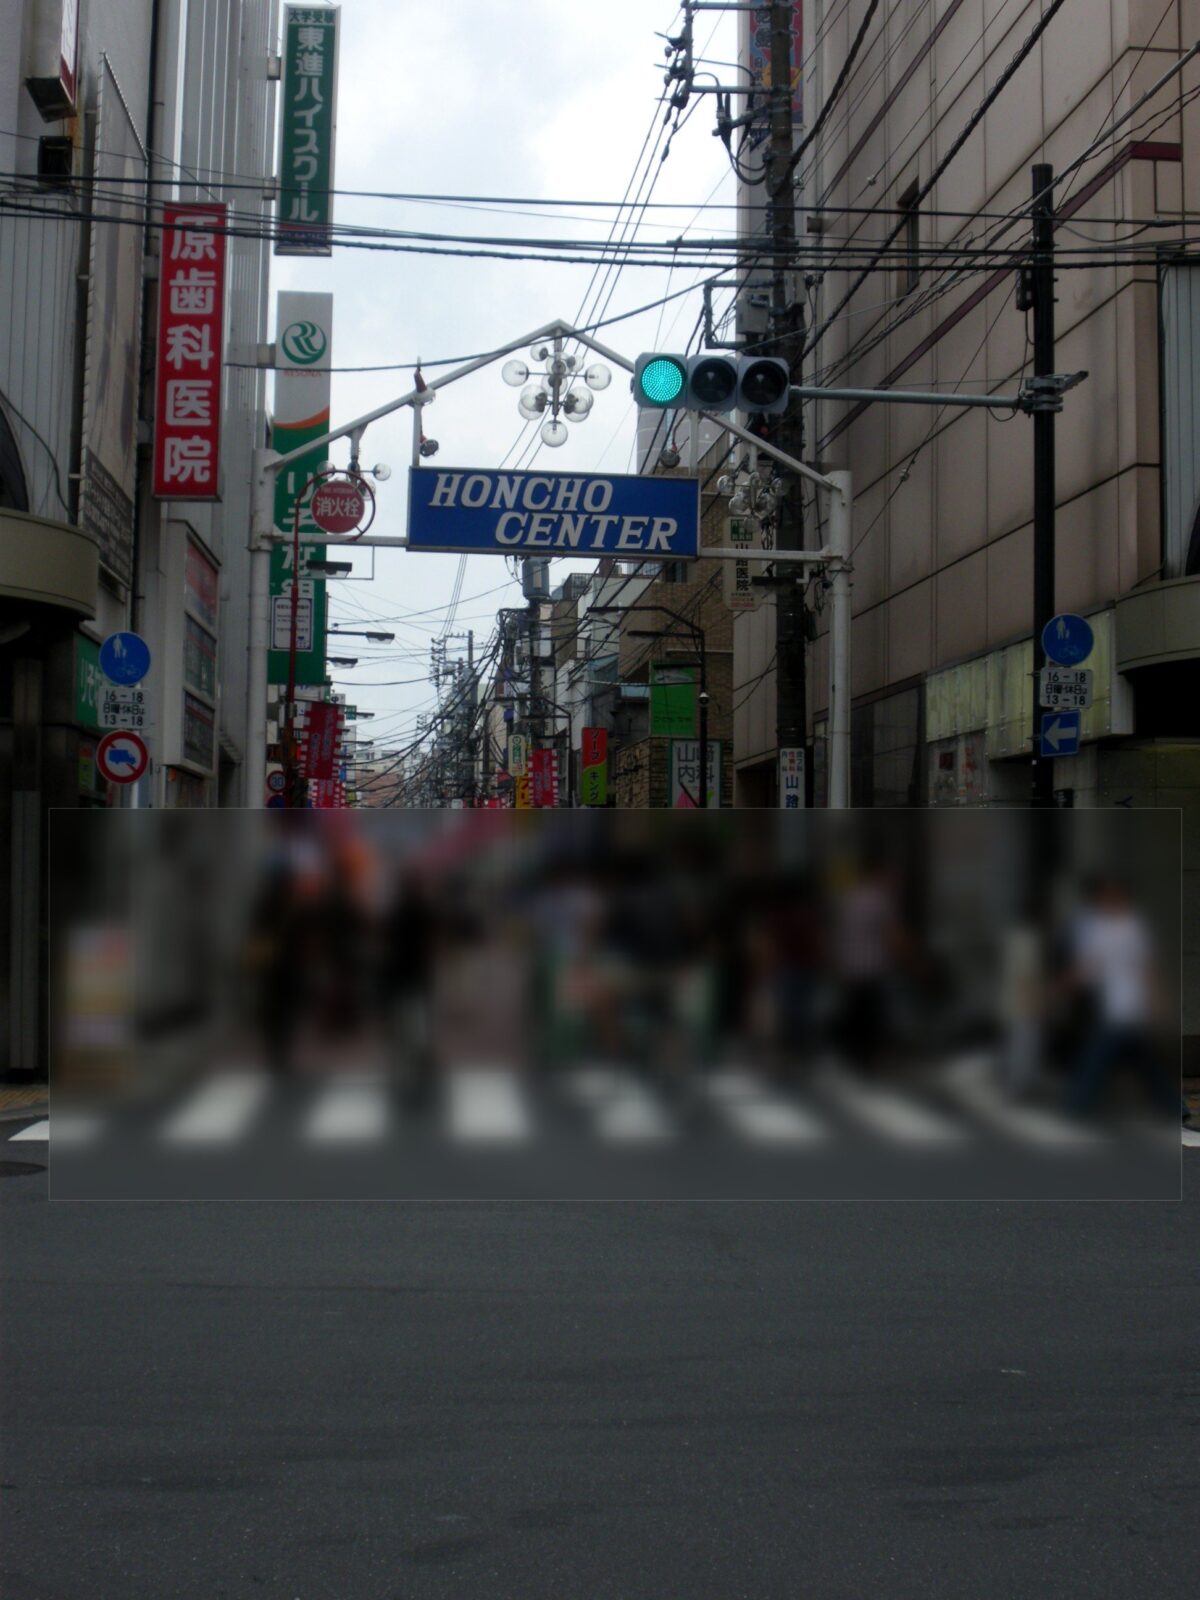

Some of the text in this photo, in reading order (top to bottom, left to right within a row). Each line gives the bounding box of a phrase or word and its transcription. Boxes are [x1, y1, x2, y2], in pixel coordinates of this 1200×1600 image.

[289, 27, 325, 222] 東進ハイスクール
[163, 215, 218, 482] 原歯科医院
[316, 496, 361, 517] 消火栓
[428, 473, 614, 513] HONCHO
[495, 511, 678, 550] CENTER
